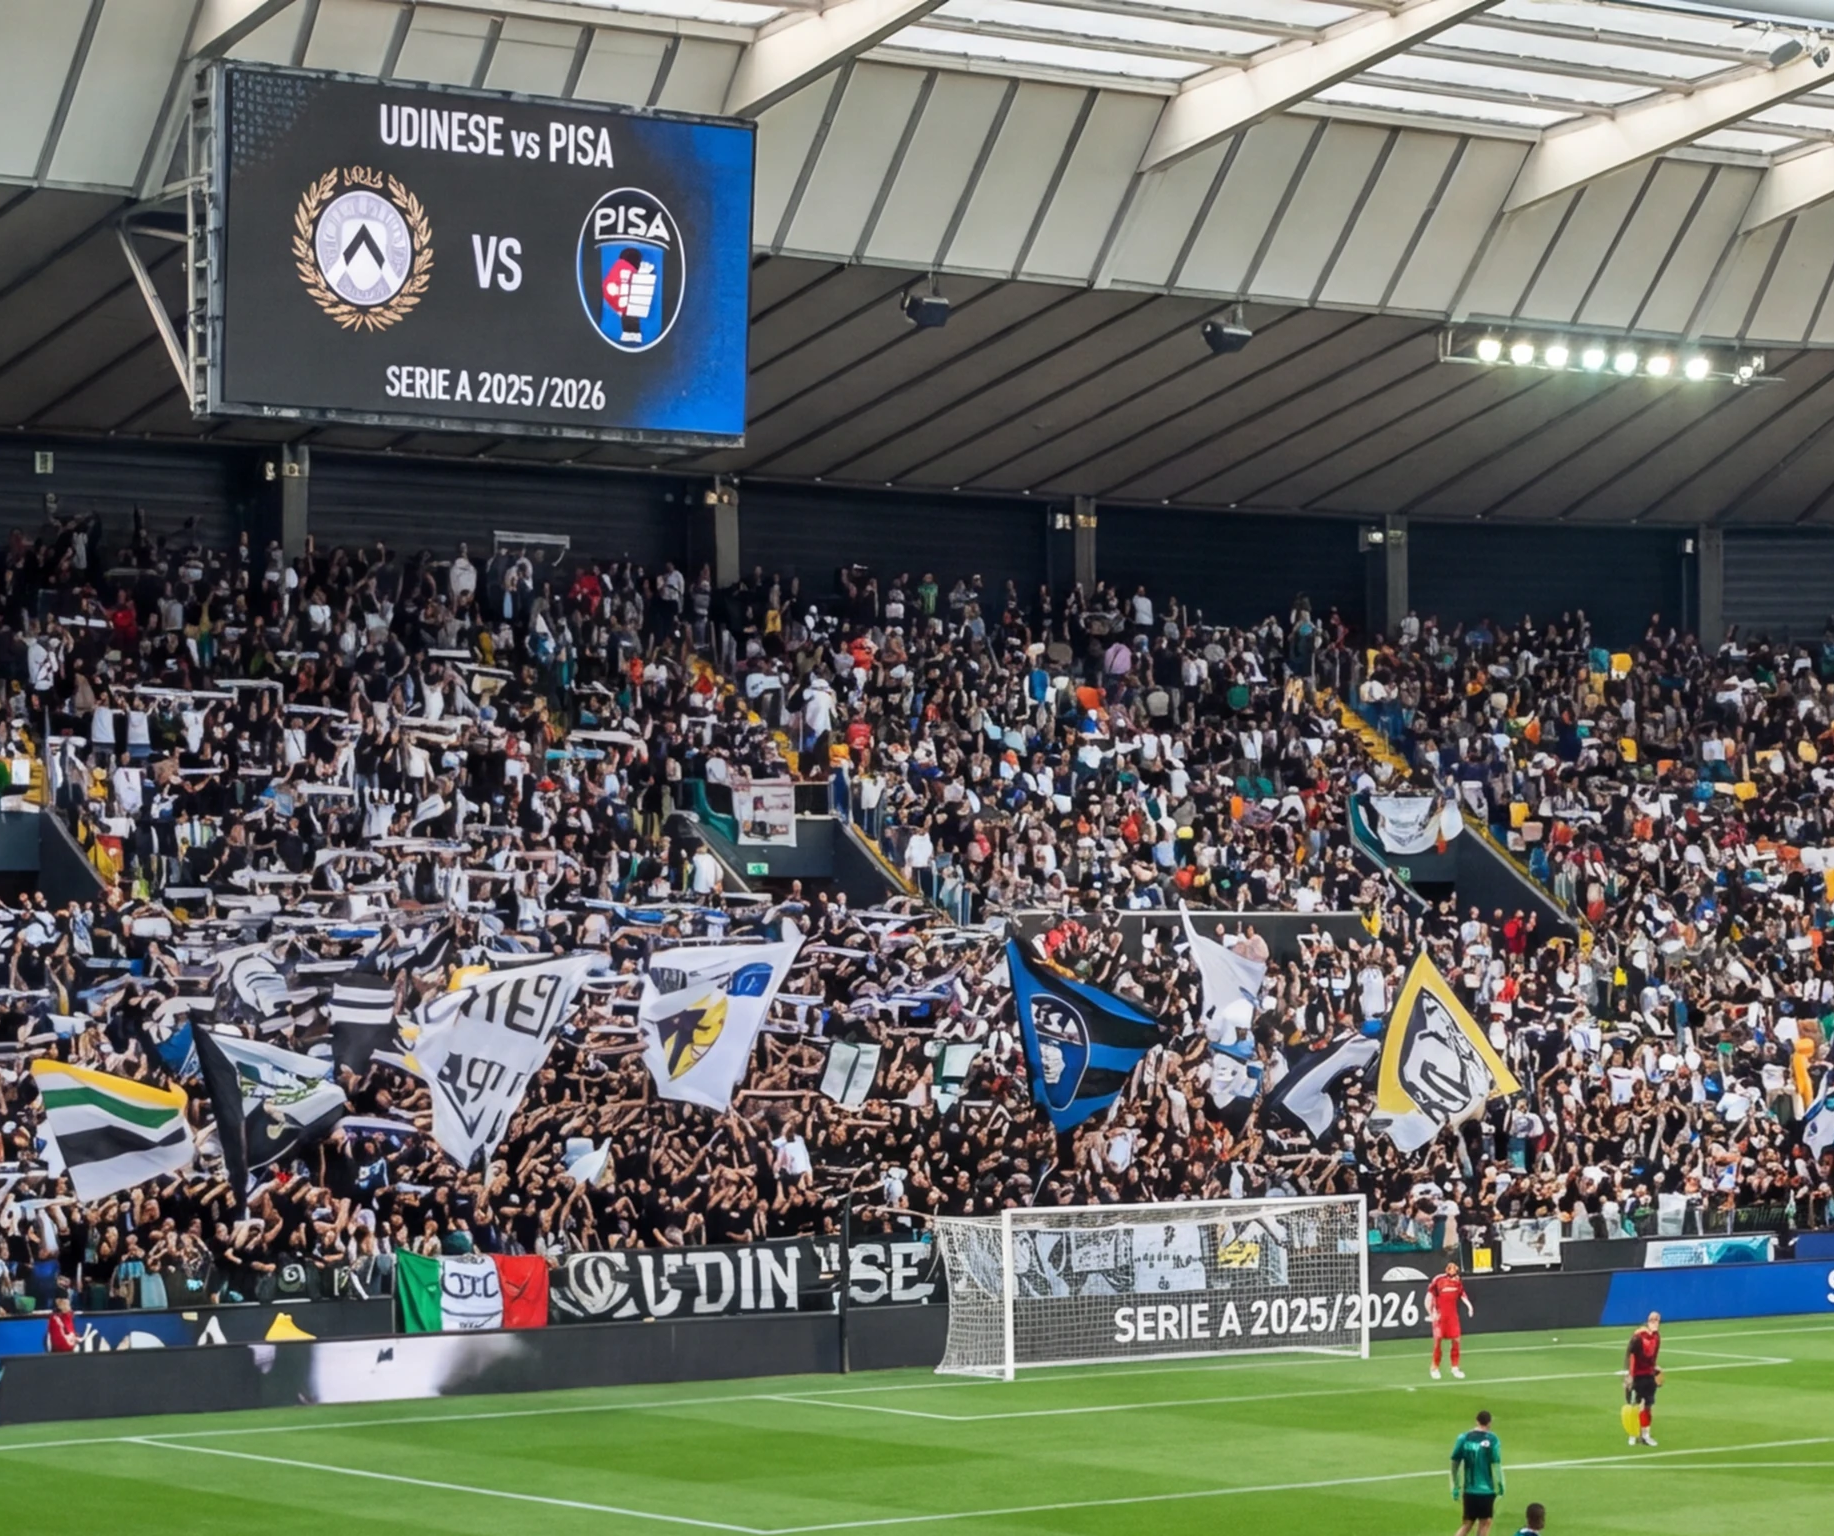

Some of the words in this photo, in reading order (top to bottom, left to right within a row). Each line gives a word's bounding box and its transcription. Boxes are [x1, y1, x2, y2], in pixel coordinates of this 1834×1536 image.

[380, 104, 503, 157] UDINESE
[511, 130, 540, 159] vs
[549, 125, 614, 169] PISA
[595, 206, 670, 242] PISA
[473, 234, 522, 291] VS
[385, 365, 450, 401] SERIE
[454, 371, 473, 402] A
[477, 372, 606, 411] 2025/2026
[1114, 1303, 1207, 1343] SERIE
[1218, 1305, 1242, 1337] A
[1250, 1291, 1418, 1336] 2025/2026
